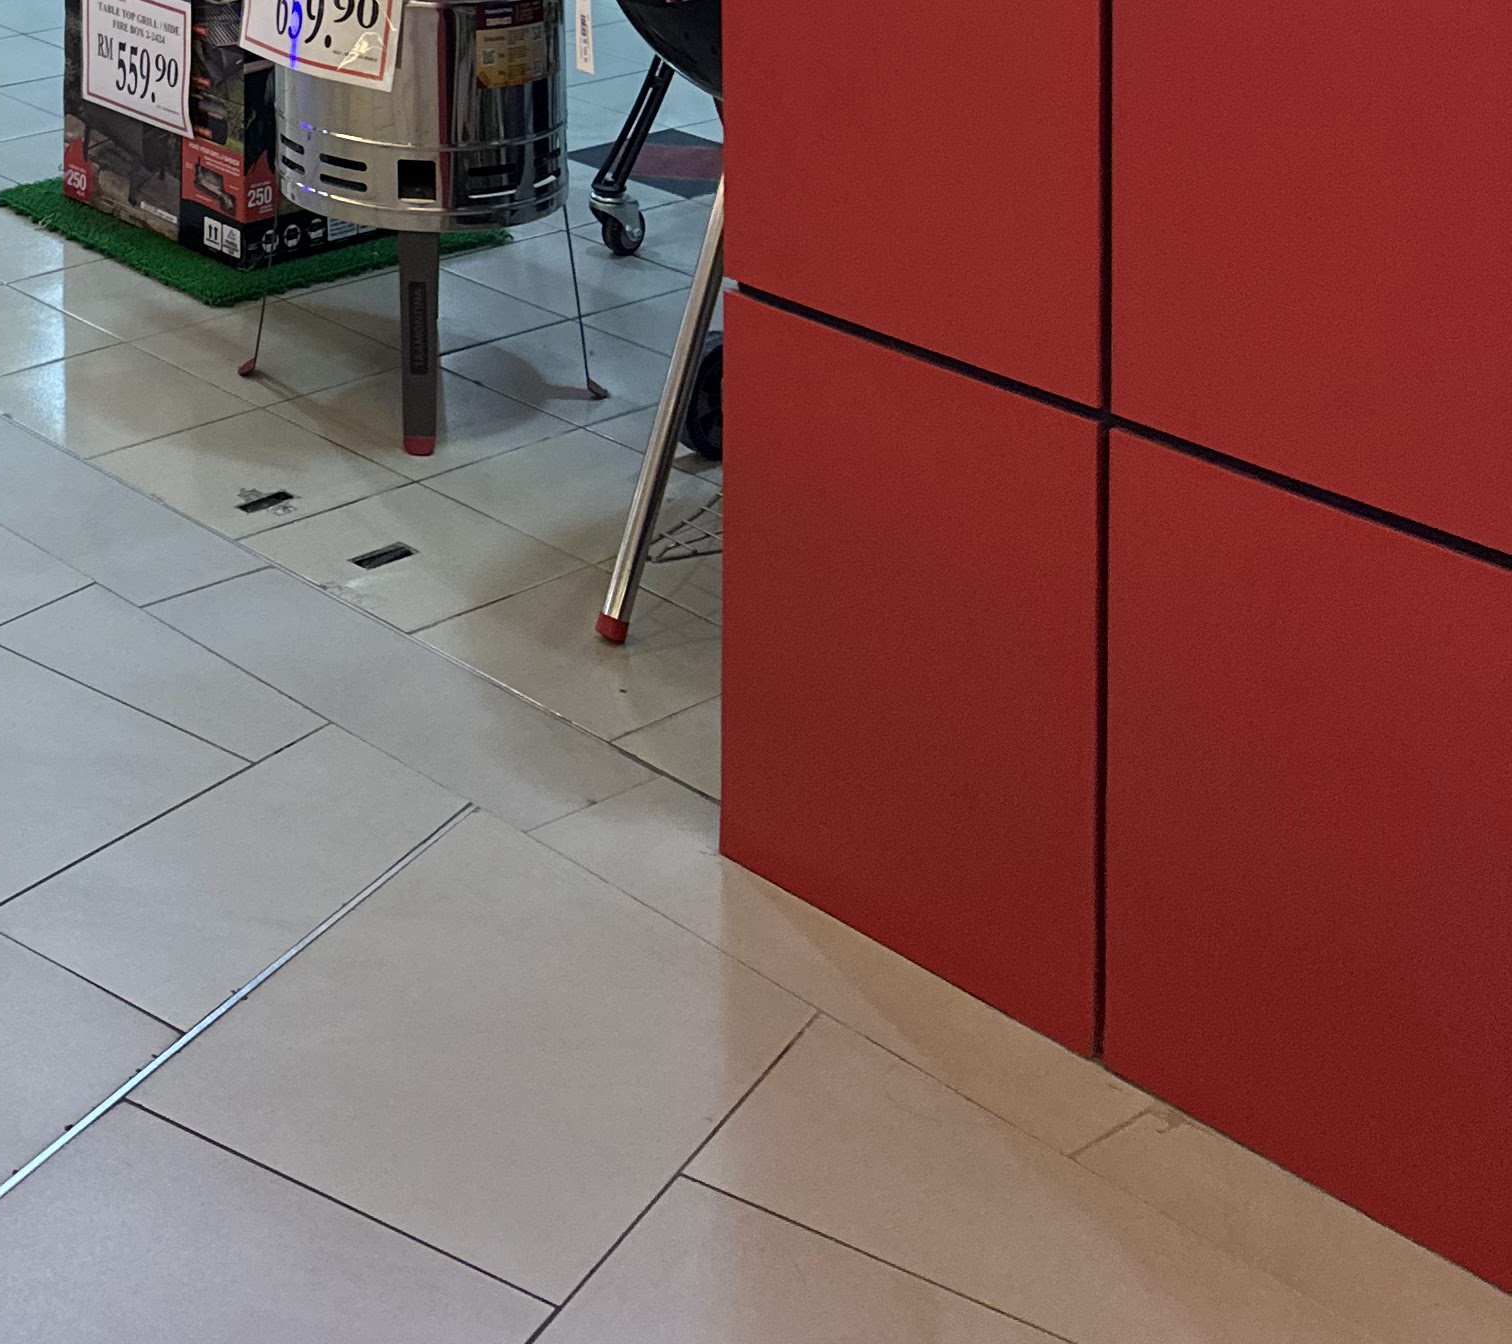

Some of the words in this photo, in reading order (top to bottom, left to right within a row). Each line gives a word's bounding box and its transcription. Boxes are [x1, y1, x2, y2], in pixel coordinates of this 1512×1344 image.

[98, 1, 121, 17] TABLE
[121, 8, 136, 22] TOP
[136, 13, 158, 30] GRILL
[112, 19, 129, 33] FIRE
[129, 24, 145, 38] BOX
[97, 33, 114, 61] RM
[115, 41, 179, 104] 559.90
[67, 168, 87, 191] 250
[247, 185, 273, 208] 250
